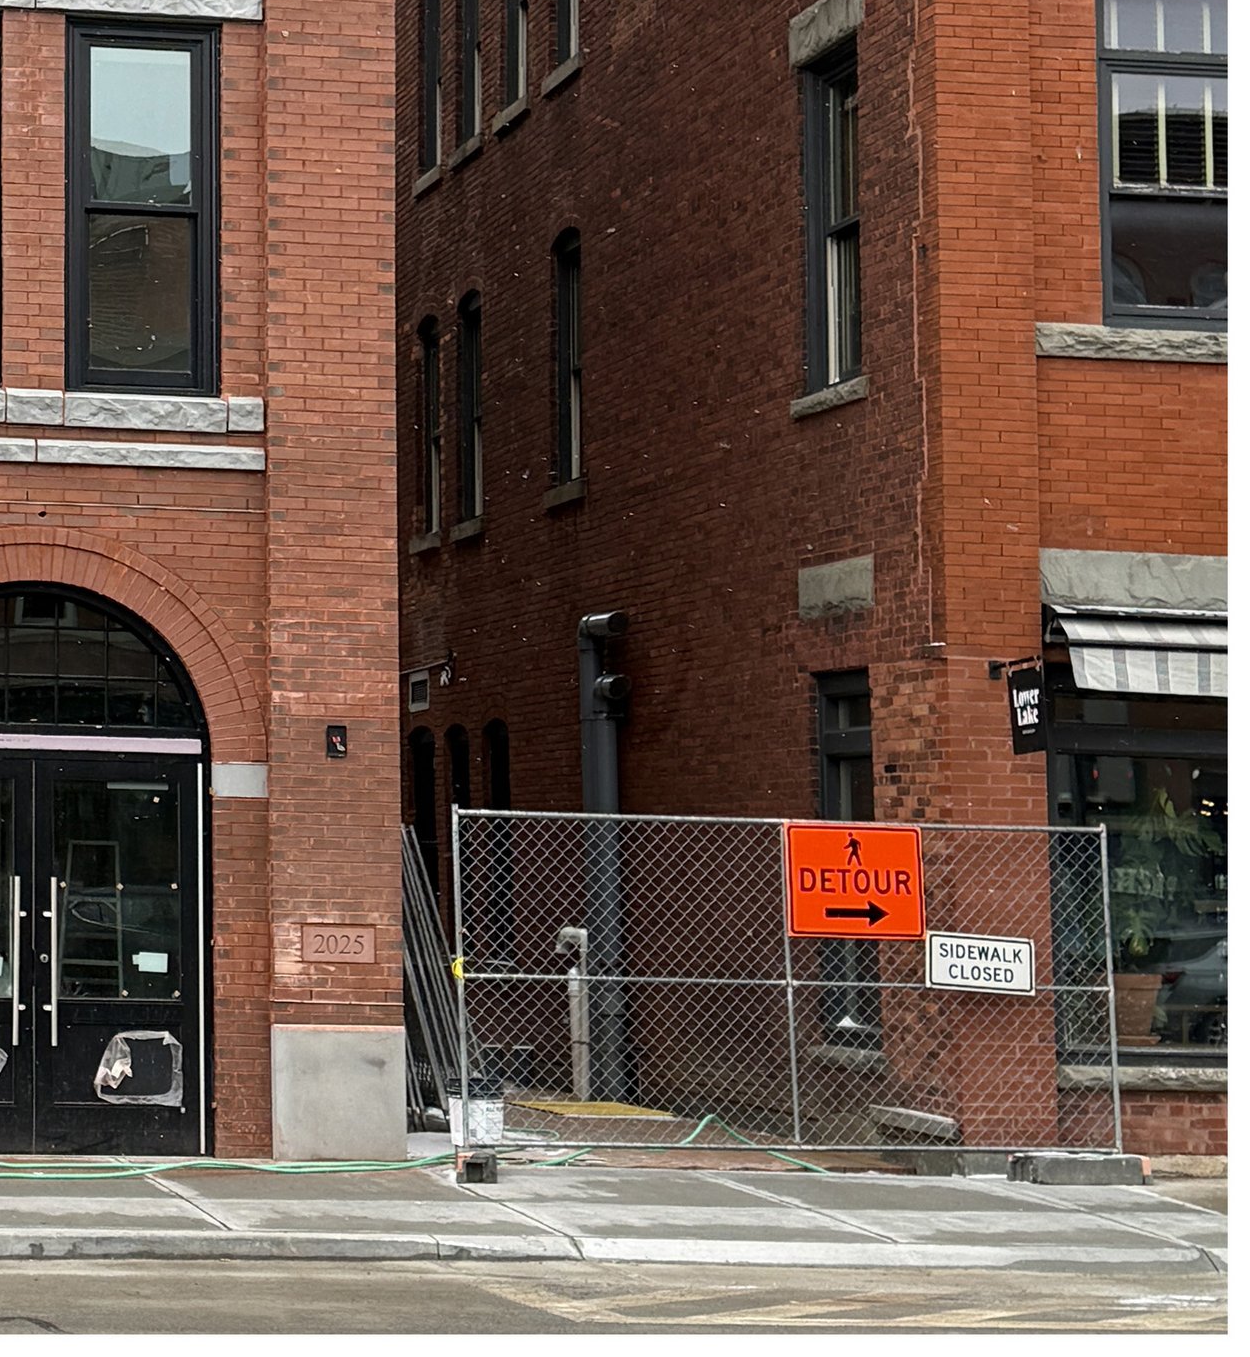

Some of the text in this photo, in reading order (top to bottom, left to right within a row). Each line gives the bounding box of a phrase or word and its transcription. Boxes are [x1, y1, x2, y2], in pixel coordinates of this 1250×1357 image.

[1013, 688, 1040, 708] Lower
[1016, 705, 1039, 726] Lake
[799, 867, 912, 895] DETOUR
[313, 933, 365, 955] 2025
[939, 942, 1023, 964] SIDEWALK
[948, 964, 1014, 983] CLOSED
